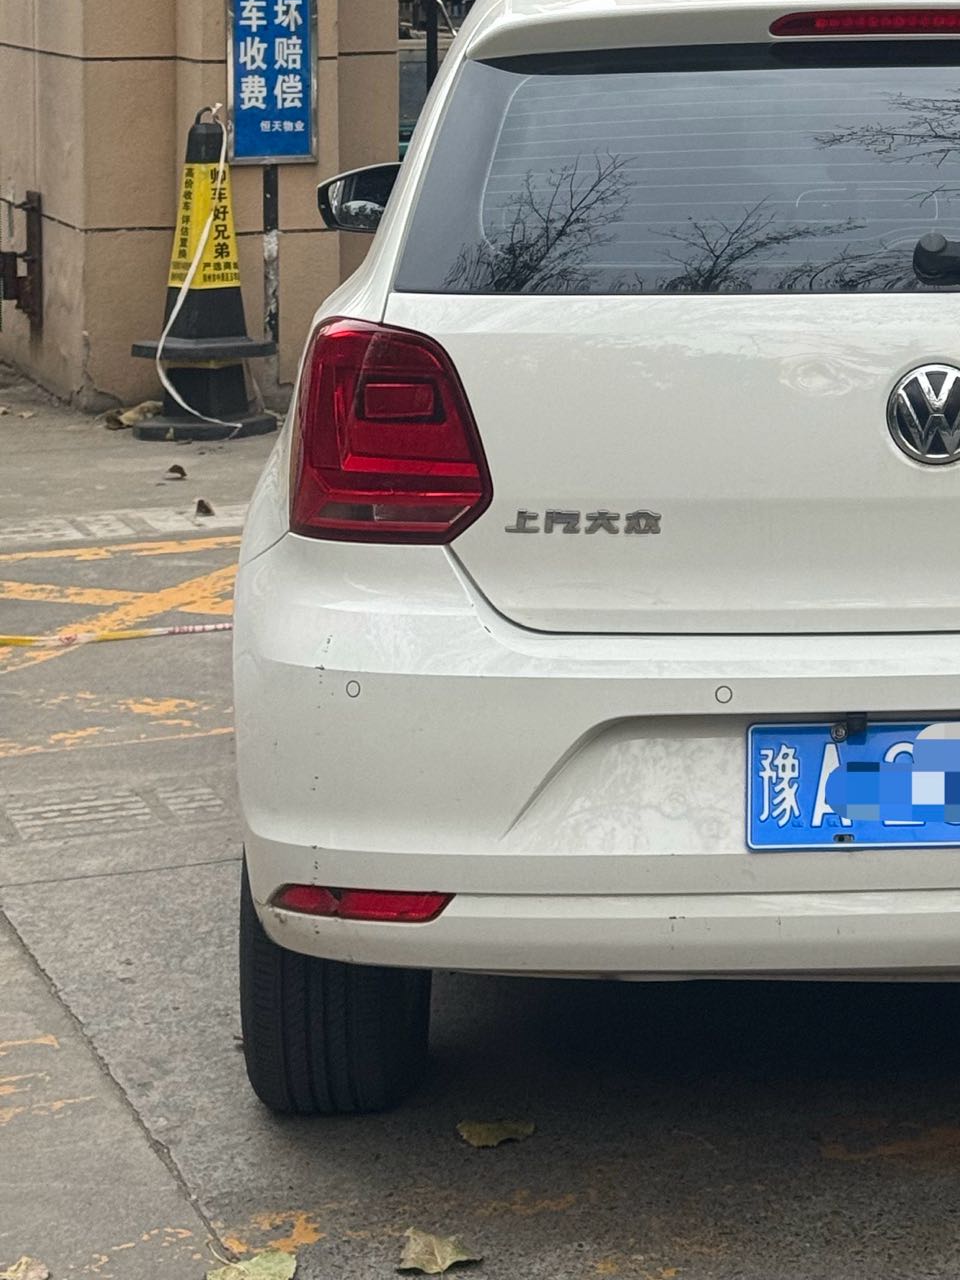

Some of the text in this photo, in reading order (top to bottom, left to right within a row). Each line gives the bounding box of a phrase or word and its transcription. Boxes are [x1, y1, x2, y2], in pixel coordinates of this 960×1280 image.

[260, 120, 305, 132] 恒天物业
[504, 509, 662, 535] 上汽大众
